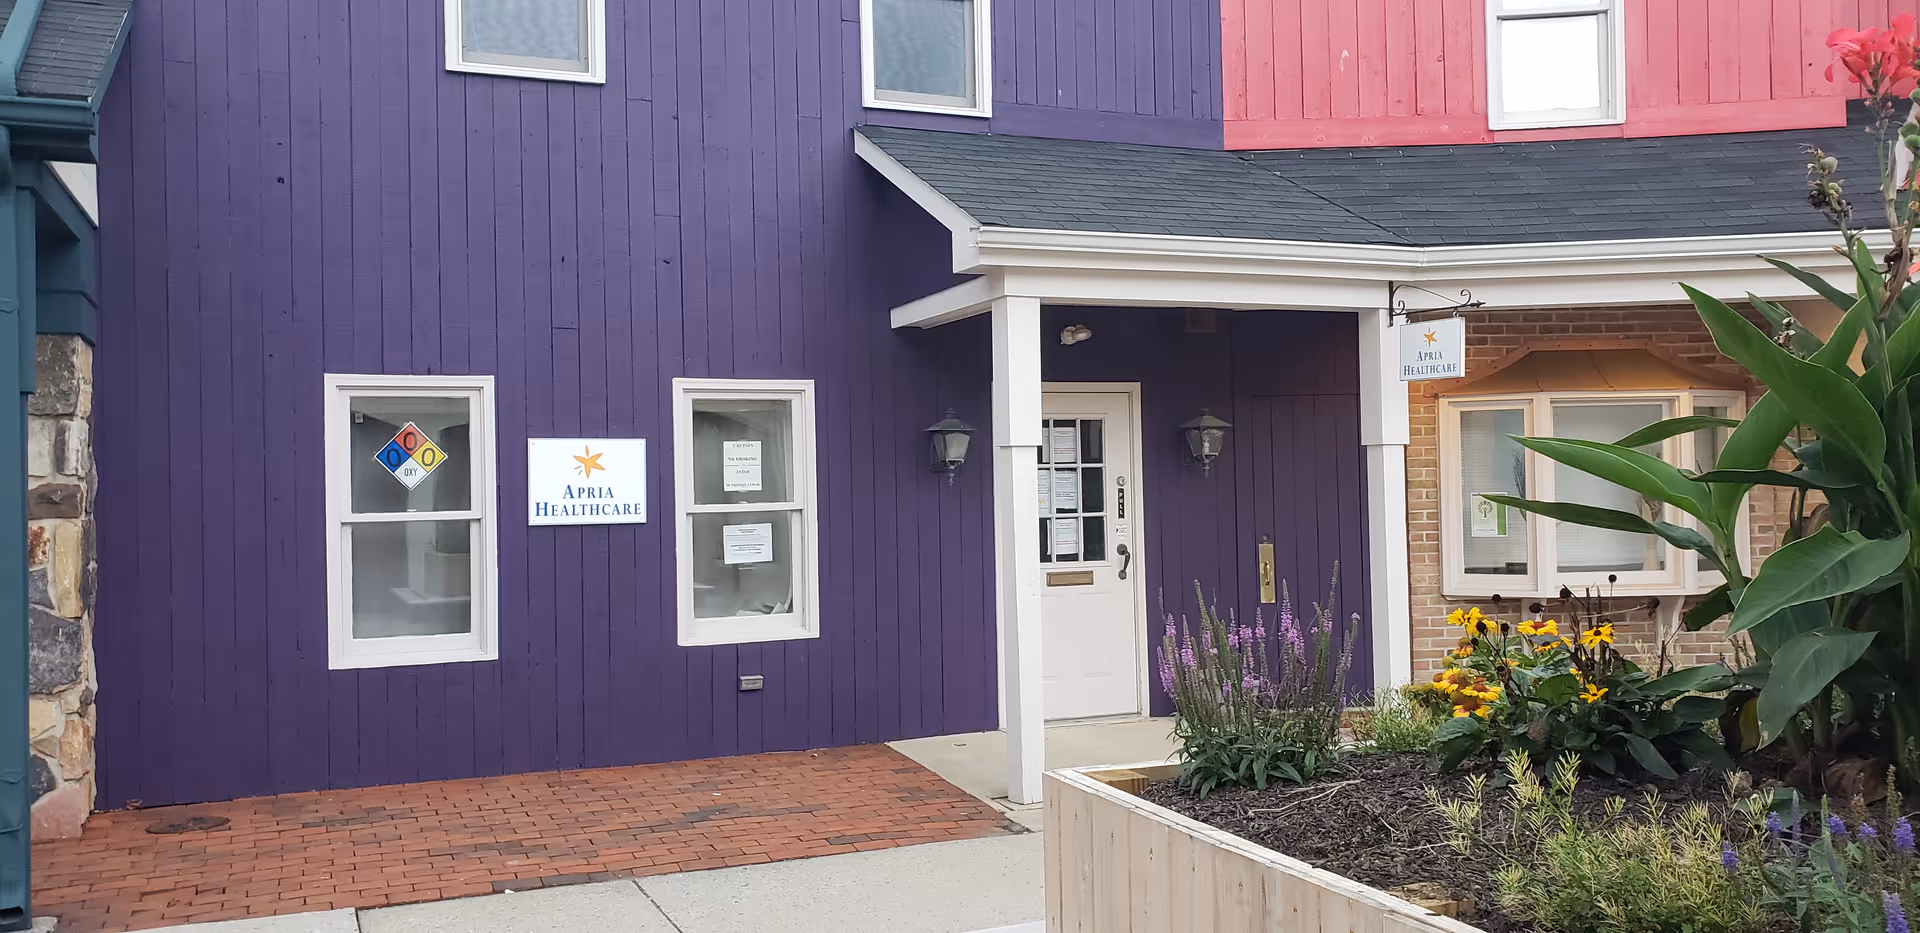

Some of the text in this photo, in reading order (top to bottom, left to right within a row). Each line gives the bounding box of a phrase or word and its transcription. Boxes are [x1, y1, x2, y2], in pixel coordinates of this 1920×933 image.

[1416, 351, 1443, 362] APRIA
[1403, 363, 1457, 376] HEALTHCARE
[404, 468, 418, 477] OXY
[562, 484, 615, 499] APRIA
[534, 502, 642, 517] HEALTHCARE
